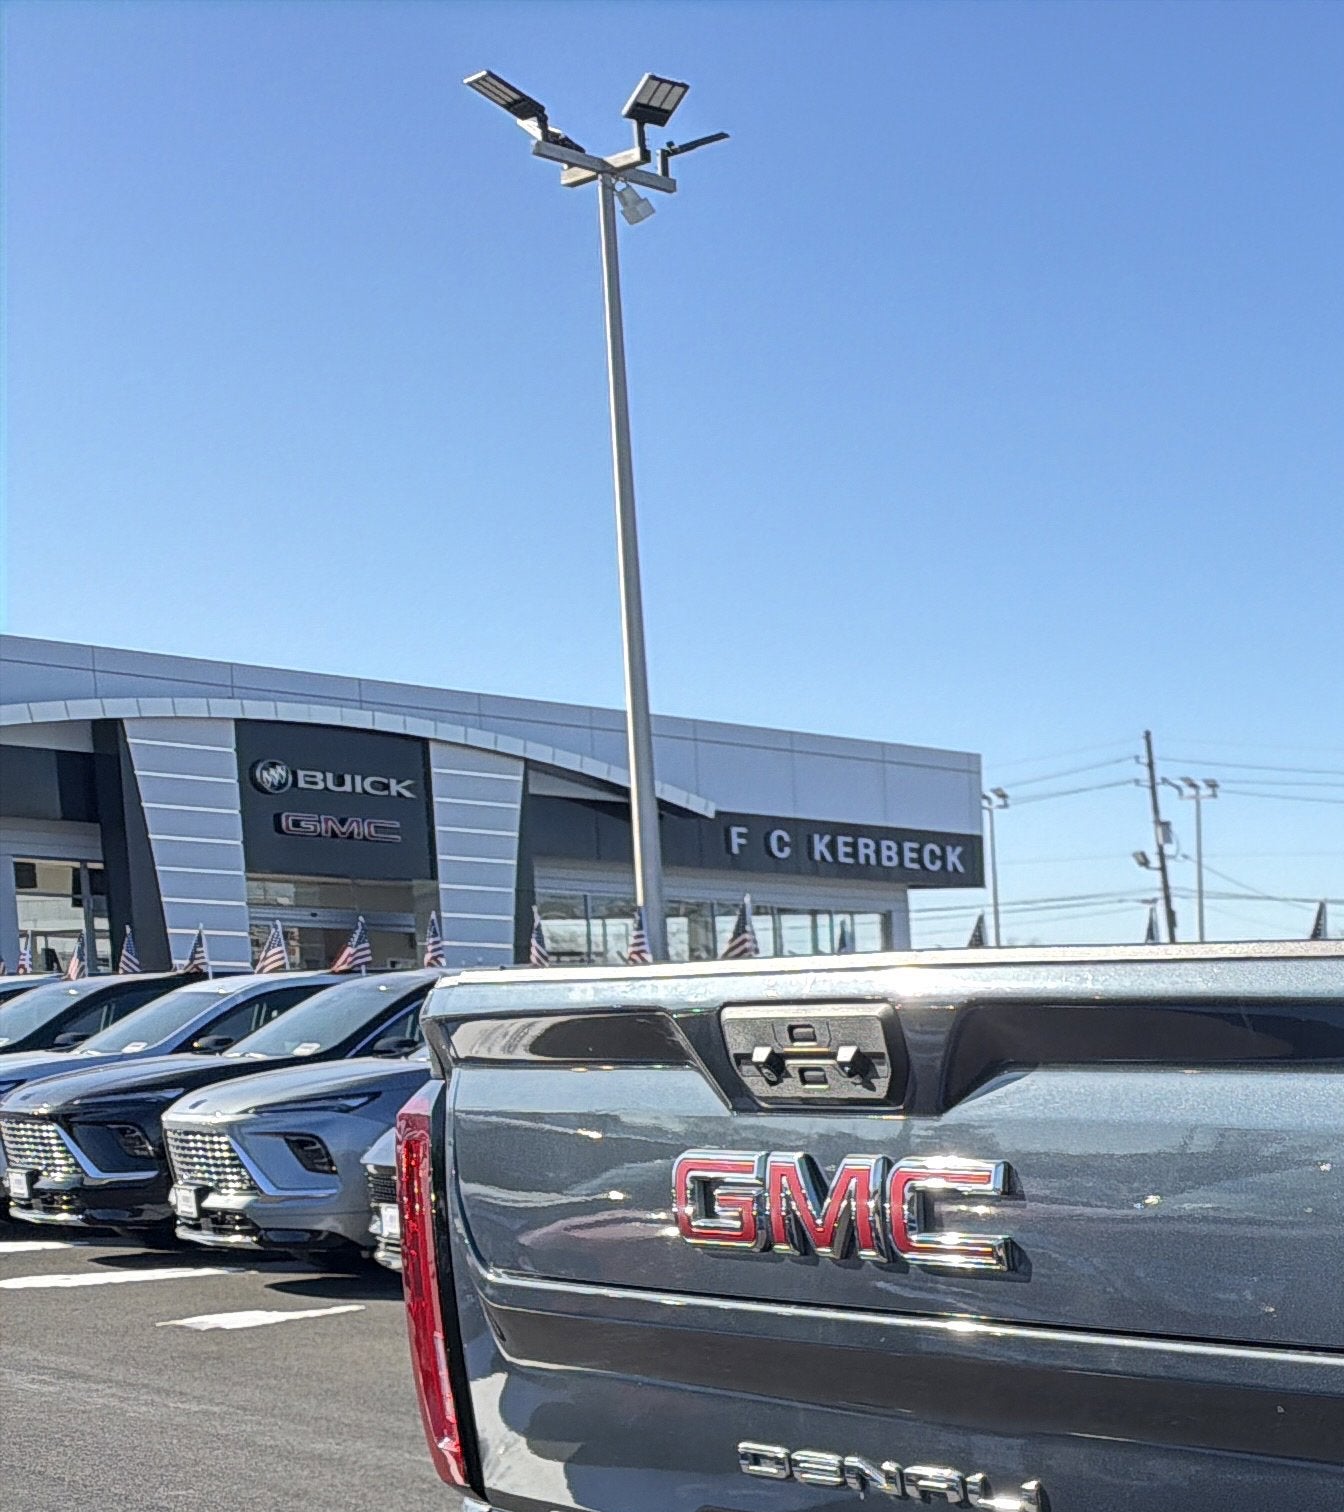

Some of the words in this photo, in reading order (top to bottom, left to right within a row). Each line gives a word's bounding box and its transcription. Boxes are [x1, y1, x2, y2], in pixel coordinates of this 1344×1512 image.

[296, 769, 417, 799] BUICK
[278, 811, 402, 843] GMC
[729, 826, 749, 855] F
[769, 829, 792, 859] C
[812, 833, 965, 874] KERBECK
[671, 1148, 1019, 1273] GMC
